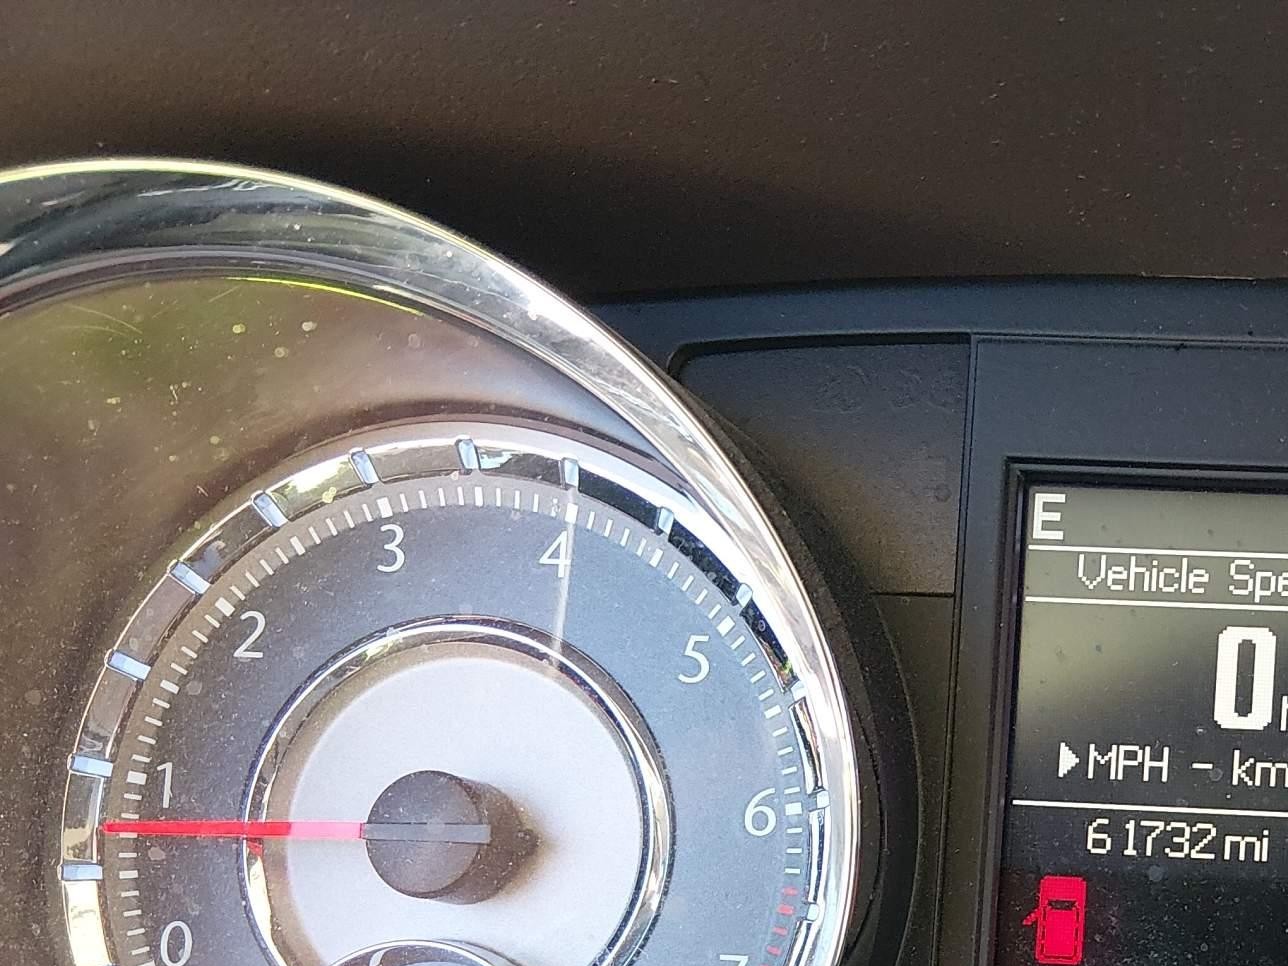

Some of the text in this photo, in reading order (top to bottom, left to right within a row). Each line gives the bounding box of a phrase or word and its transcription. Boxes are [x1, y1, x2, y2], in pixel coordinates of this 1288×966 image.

[1033, 493, 1065, 540] E
[377, 523, 406, 574] 3
[539, 530, 573, 578] 4
[1078, 553, 1209, 593] Vehicle
[233, 610, 267, 659] 2
[678, 634, 711, 684] 5
[1214, 626, 1276, 730] 0
[157, 762, 174, 808] 1
[1088, 744, 1169, 782] MPH
[743, 787, 779, 837] 6
